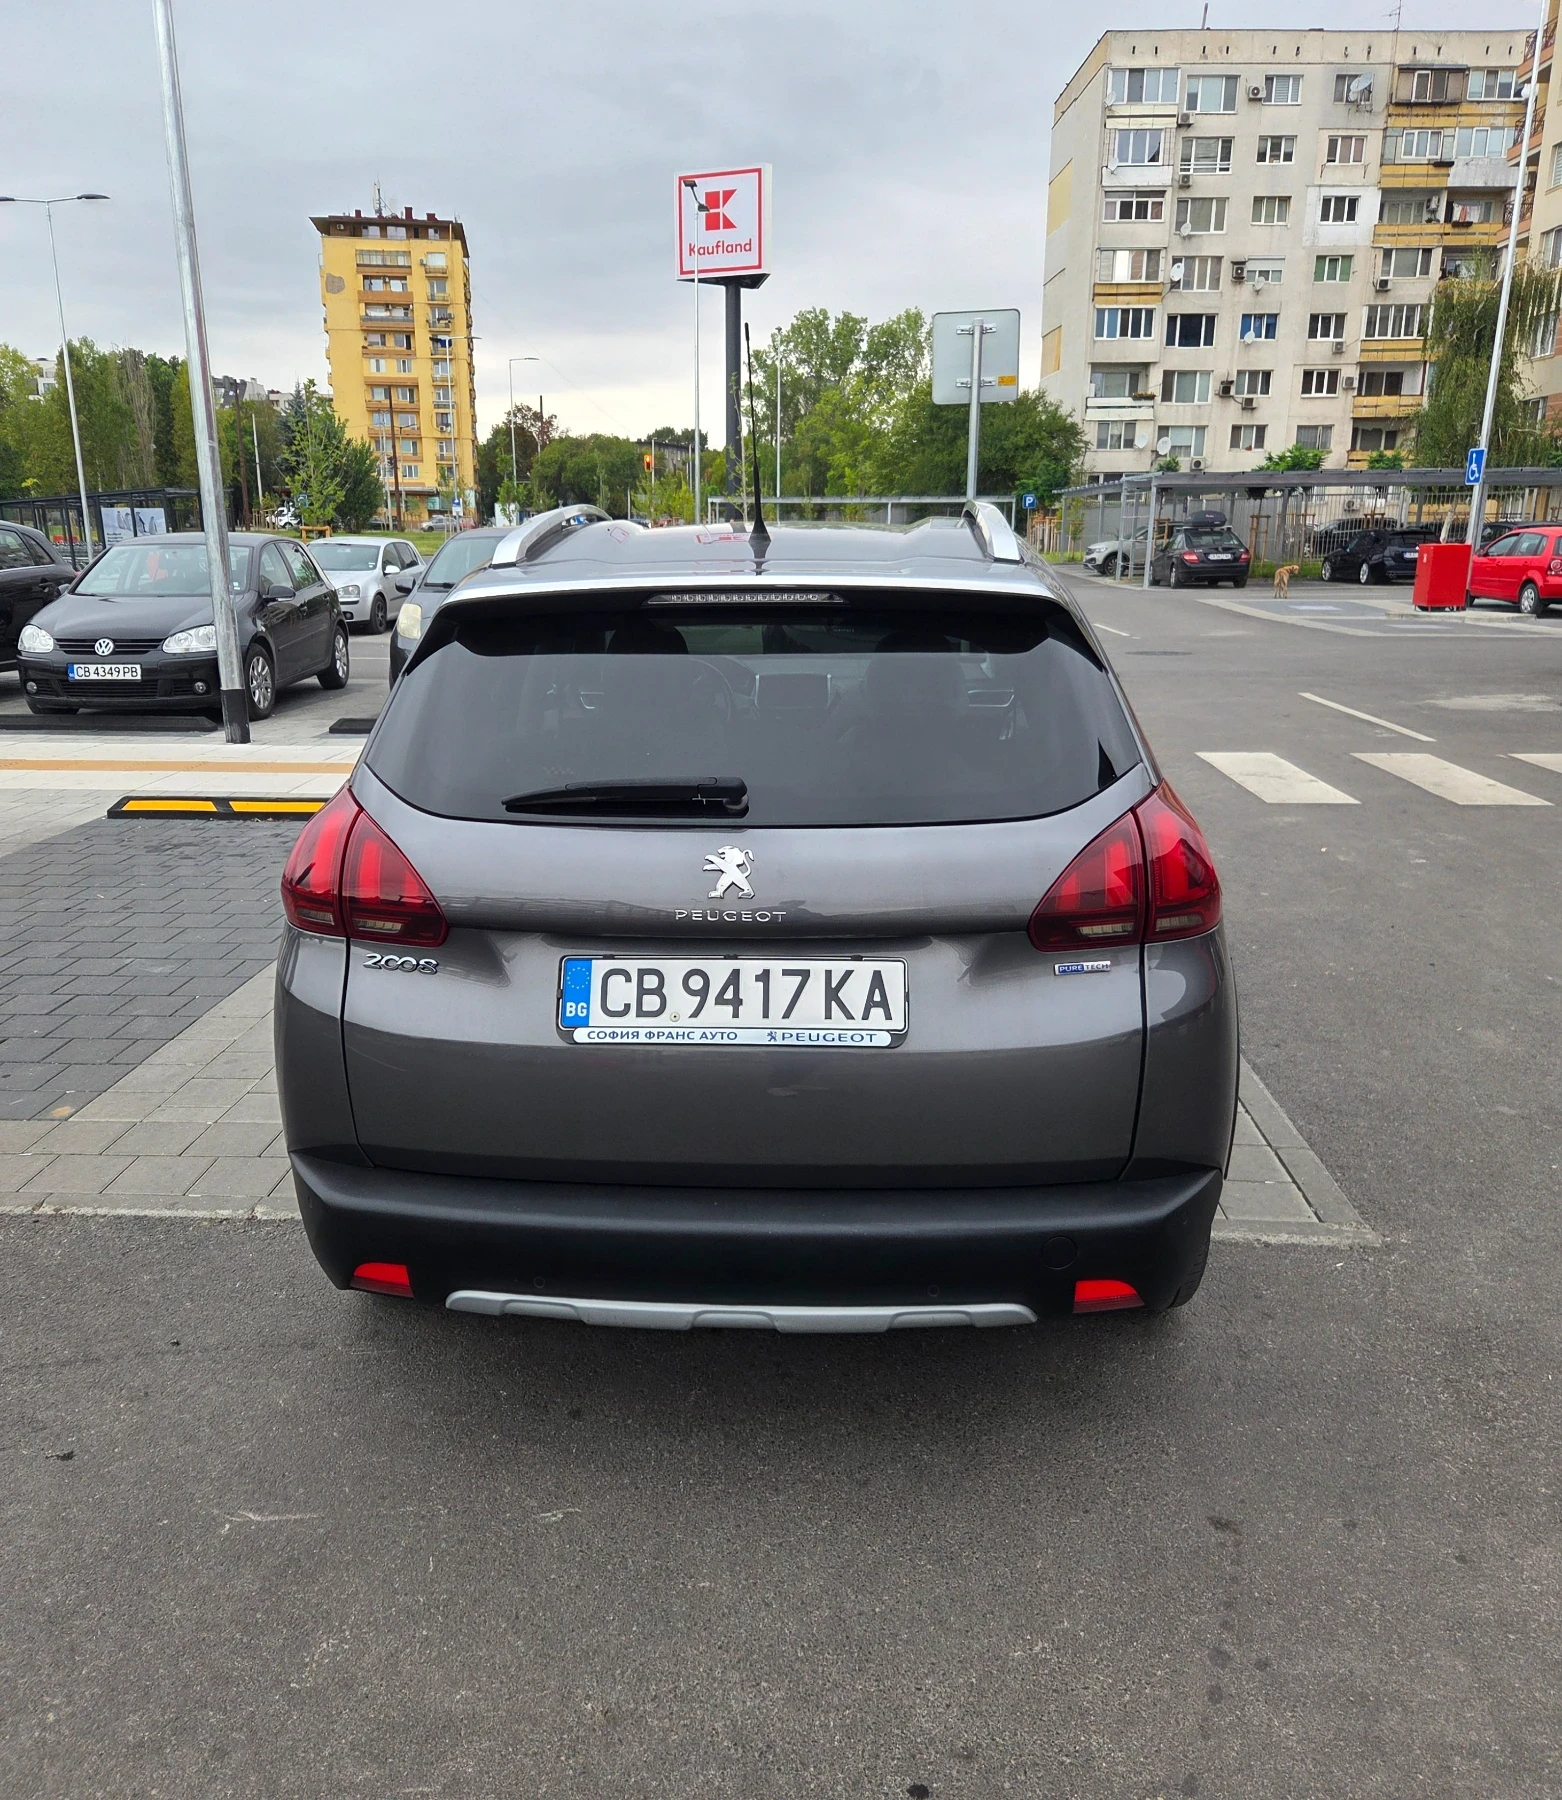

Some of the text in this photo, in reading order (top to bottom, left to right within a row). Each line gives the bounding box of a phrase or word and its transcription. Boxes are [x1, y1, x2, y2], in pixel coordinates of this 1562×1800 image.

[688, 237, 752, 257] Kaufland
[1025, 496, 1034, 507] P
[76, 666, 91, 678] CB
[93, 666, 121, 678] 4349
[123, 666, 138, 678] PB
[674, 909, 787, 922] PEUGEOT
[362, 953, 438, 975] 2008
[600, 968, 893, 1020] CB 9417 KA
[565, 1001, 587, 1017] BG
[587, 1030, 738, 1041] СОФИЯ ФРАНС АУТО
[781, 1032, 877, 1043] PEUGEOT
